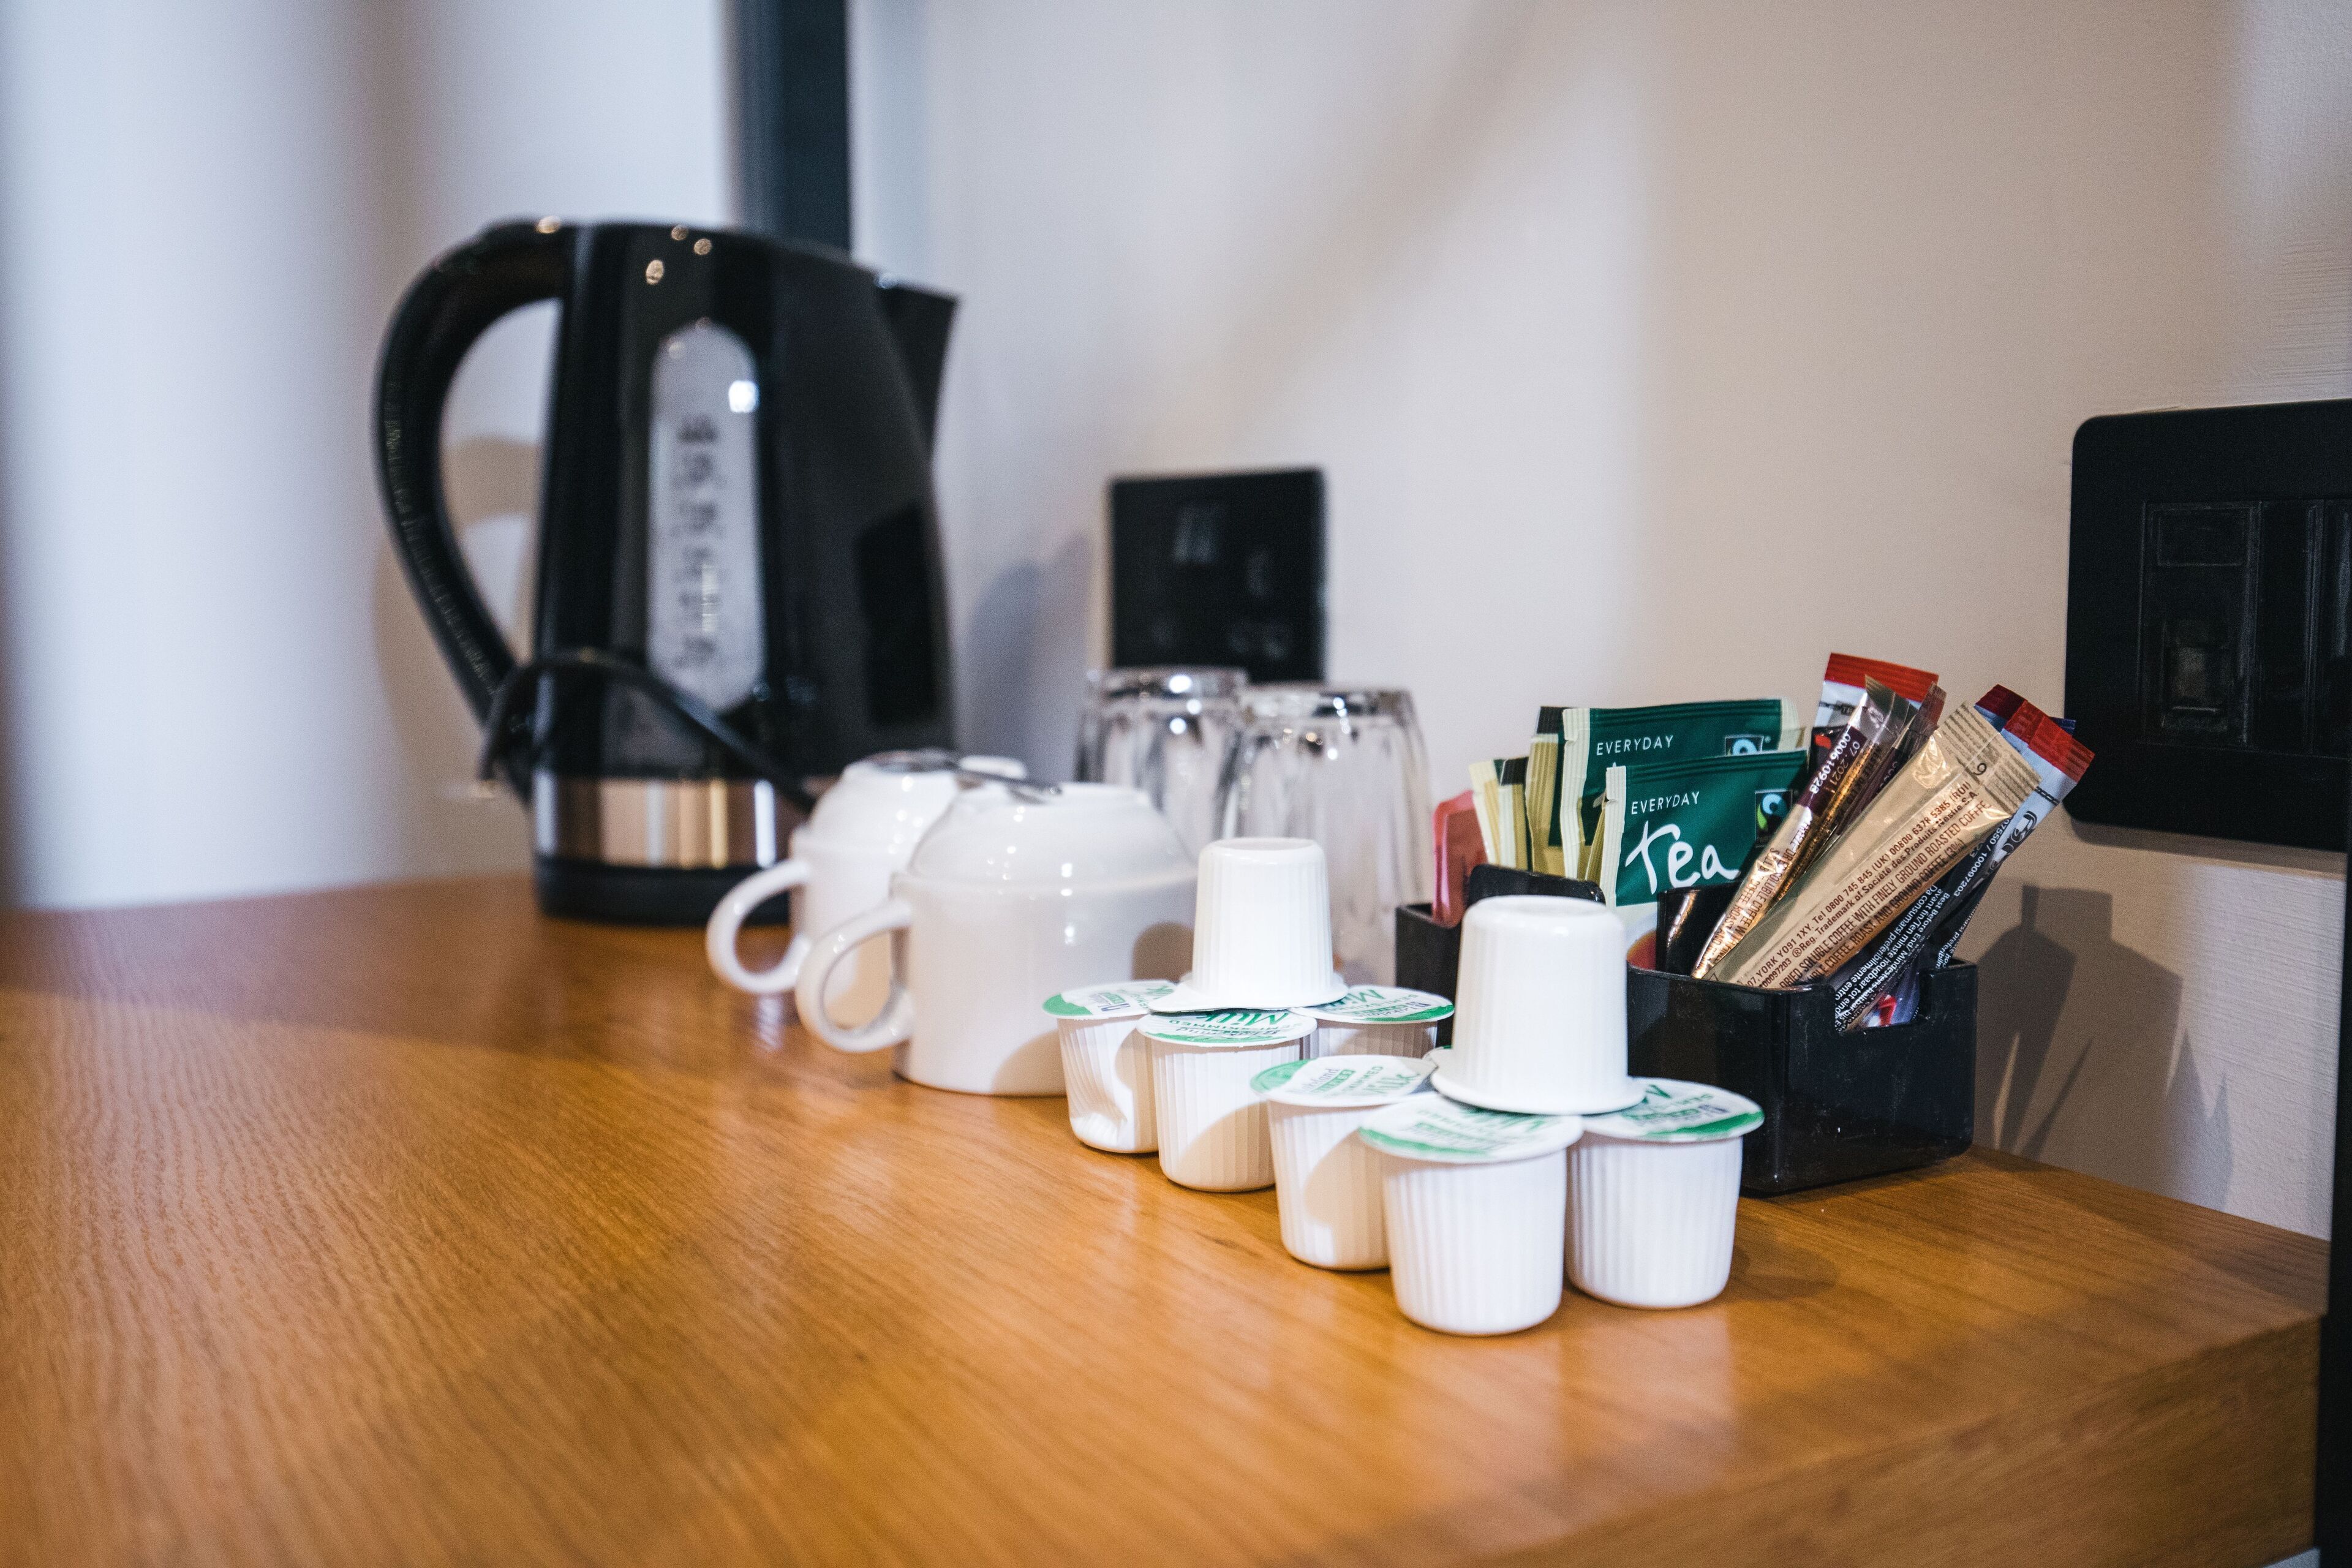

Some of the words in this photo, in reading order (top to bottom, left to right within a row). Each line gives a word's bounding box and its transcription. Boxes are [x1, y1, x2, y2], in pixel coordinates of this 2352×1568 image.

[1596, 734, 1673, 756] EVERYDAY
[1631, 791, 1700, 815] EVERYDAY
[1625, 821, 1741, 895] Tea
[1776, 938, 1798, 959] YO91
[1795, 922, 1814, 940] 1XY.
[1811, 910, 1826, 925] Tel
[1825, 894, 1844, 913] 0800
[1842, 881, 1859, 897] 745
[1856, 868, 1873, 884] 845
[1871, 853, 1891, 872] (UK)
[1888, 832, 1913, 856] 00800
[1912, 816, 1932, 835] 6378
[1930, 799, 1951, 819] 5385
[1949, 780, 1972, 803] (ROI)
[1815, 898, 1855, 936] Trademark
[1852, 890, 1864, 902] of
[1861, 865, 1892, 894] Société
[1890, 853, 1906, 869] des
[1904, 824, 1937, 856] Produits
[1961, 788, 1980, 806] S.A.
[1755, 869, 1782, 902] SOLUBLE
[1953, 851, 1988, 897] 100097203
[1798, 940, 1833, 973] SOLUBLE
[1827, 918, 1856, 945] COFFEE
[1852, 899, 1876, 922] WITH
[1871, 878, 1899, 905] FINELY
[1894, 851, 1929, 884] GROUND
[1924, 821, 1962, 857] ROASTED
[1850, 919, 1877, 945] ROAST
[1873, 904, 1893, 924] AND
[1889, 876, 1923, 910] GROUND
[1918, 854, 1948, 882] COFFEE
[1924, 888, 1945, 911] avant
[1925, 883, 1938, 897] Da
[1934, 892, 1951, 910] Best
[1739, 899, 1763, 928] COFFEE
[1893, 894, 1929, 936] consumarsi
[1905, 908, 1930, 936] fin/Ten
[1917, 908, 1939, 933] Before
[1711, 928, 1728, 946] AND
[1886, 933, 1910, 959] minste
[1903, 932, 1922, 952] End/
[1849, 930, 1898, 986] preferibilmente
[1870, 948, 1909, 991] Mindestens
[1857, 954, 1891, 992] houdbaar
[1833, 979, 1855, 1003] entro
[1847, 986, 1861, 1001] tot
[1848, 984, 1874, 1013] haltbar
[1838, 1008, 1852, 1023] bis
